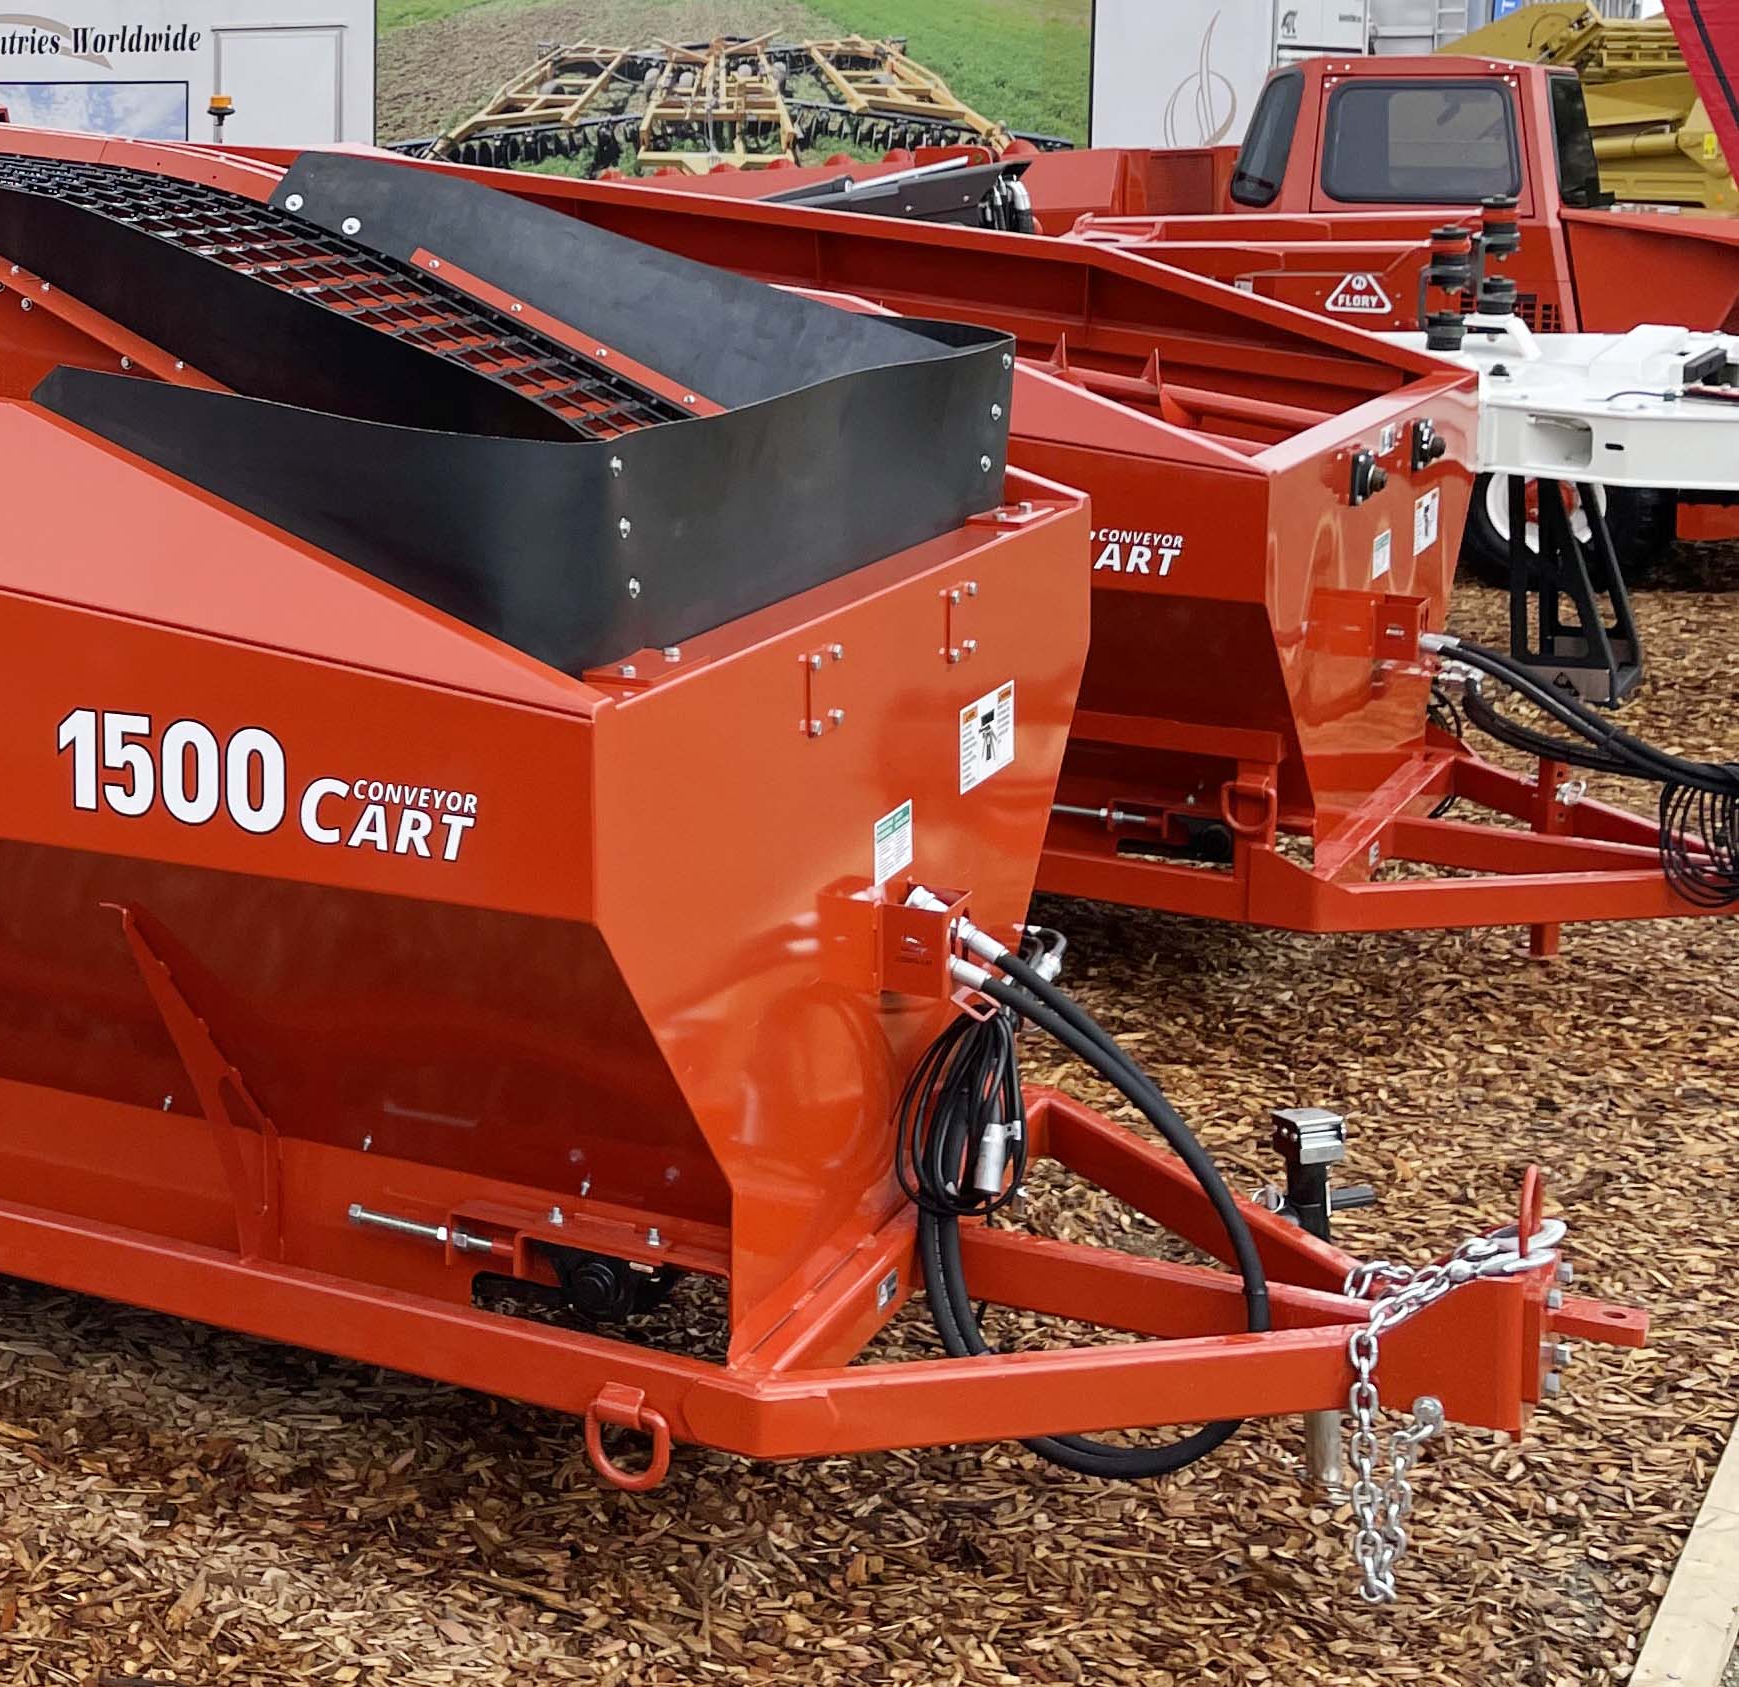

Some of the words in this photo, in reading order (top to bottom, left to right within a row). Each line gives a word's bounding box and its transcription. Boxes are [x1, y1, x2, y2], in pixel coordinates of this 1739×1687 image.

[72, 24, 201, 53] Worldwide
[1337, 293, 1379, 308] FLORY
[1090, 531, 1181, 576] ART
[1098, 528, 1183, 548] CONVEYOR
[57, 708, 287, 835] 1500
[353, 778, 479, 815] CONVEYOR
[299, 776, 476, 862] CART
